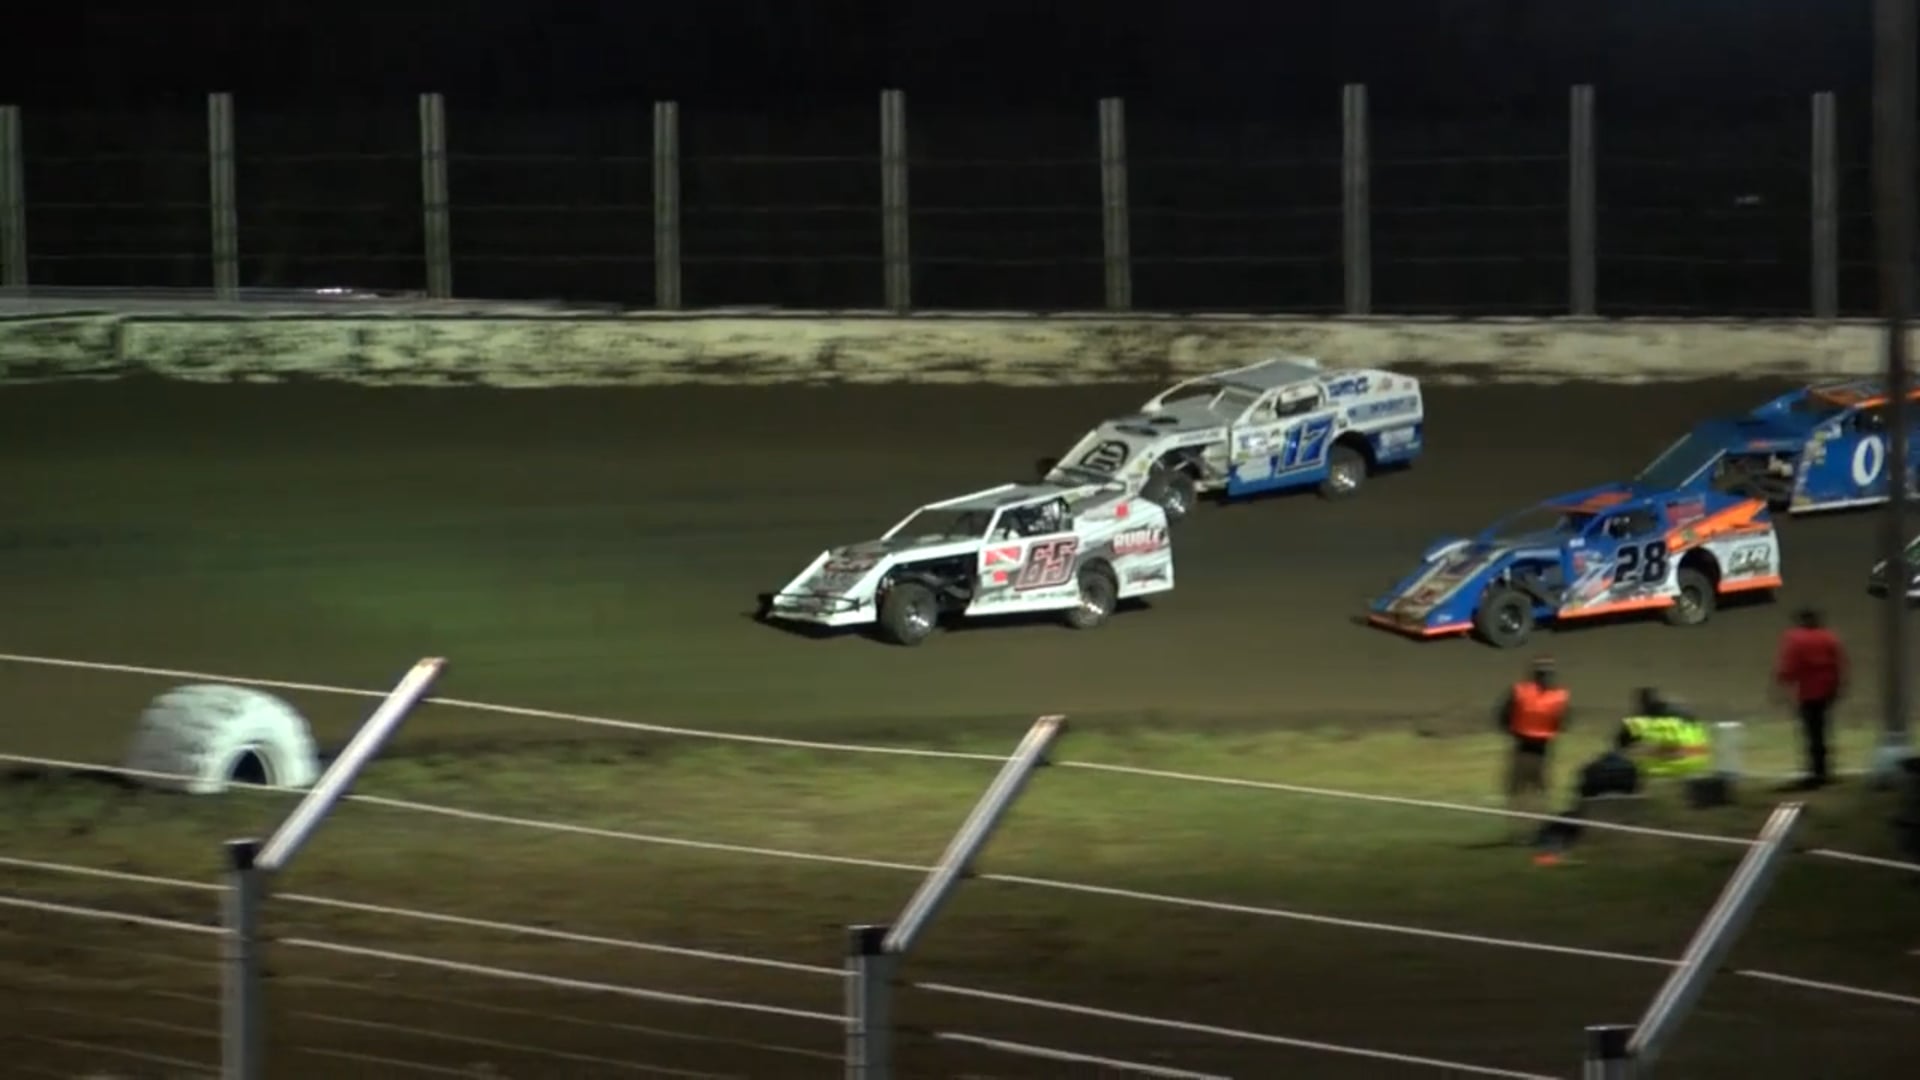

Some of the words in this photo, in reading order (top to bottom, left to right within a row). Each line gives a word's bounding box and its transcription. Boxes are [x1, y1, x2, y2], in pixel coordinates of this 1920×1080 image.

[1282, 415, 1334, 472] 17
[1015, 537, 1079, 591] 65
[1614, 541, 1667, 582] 28
